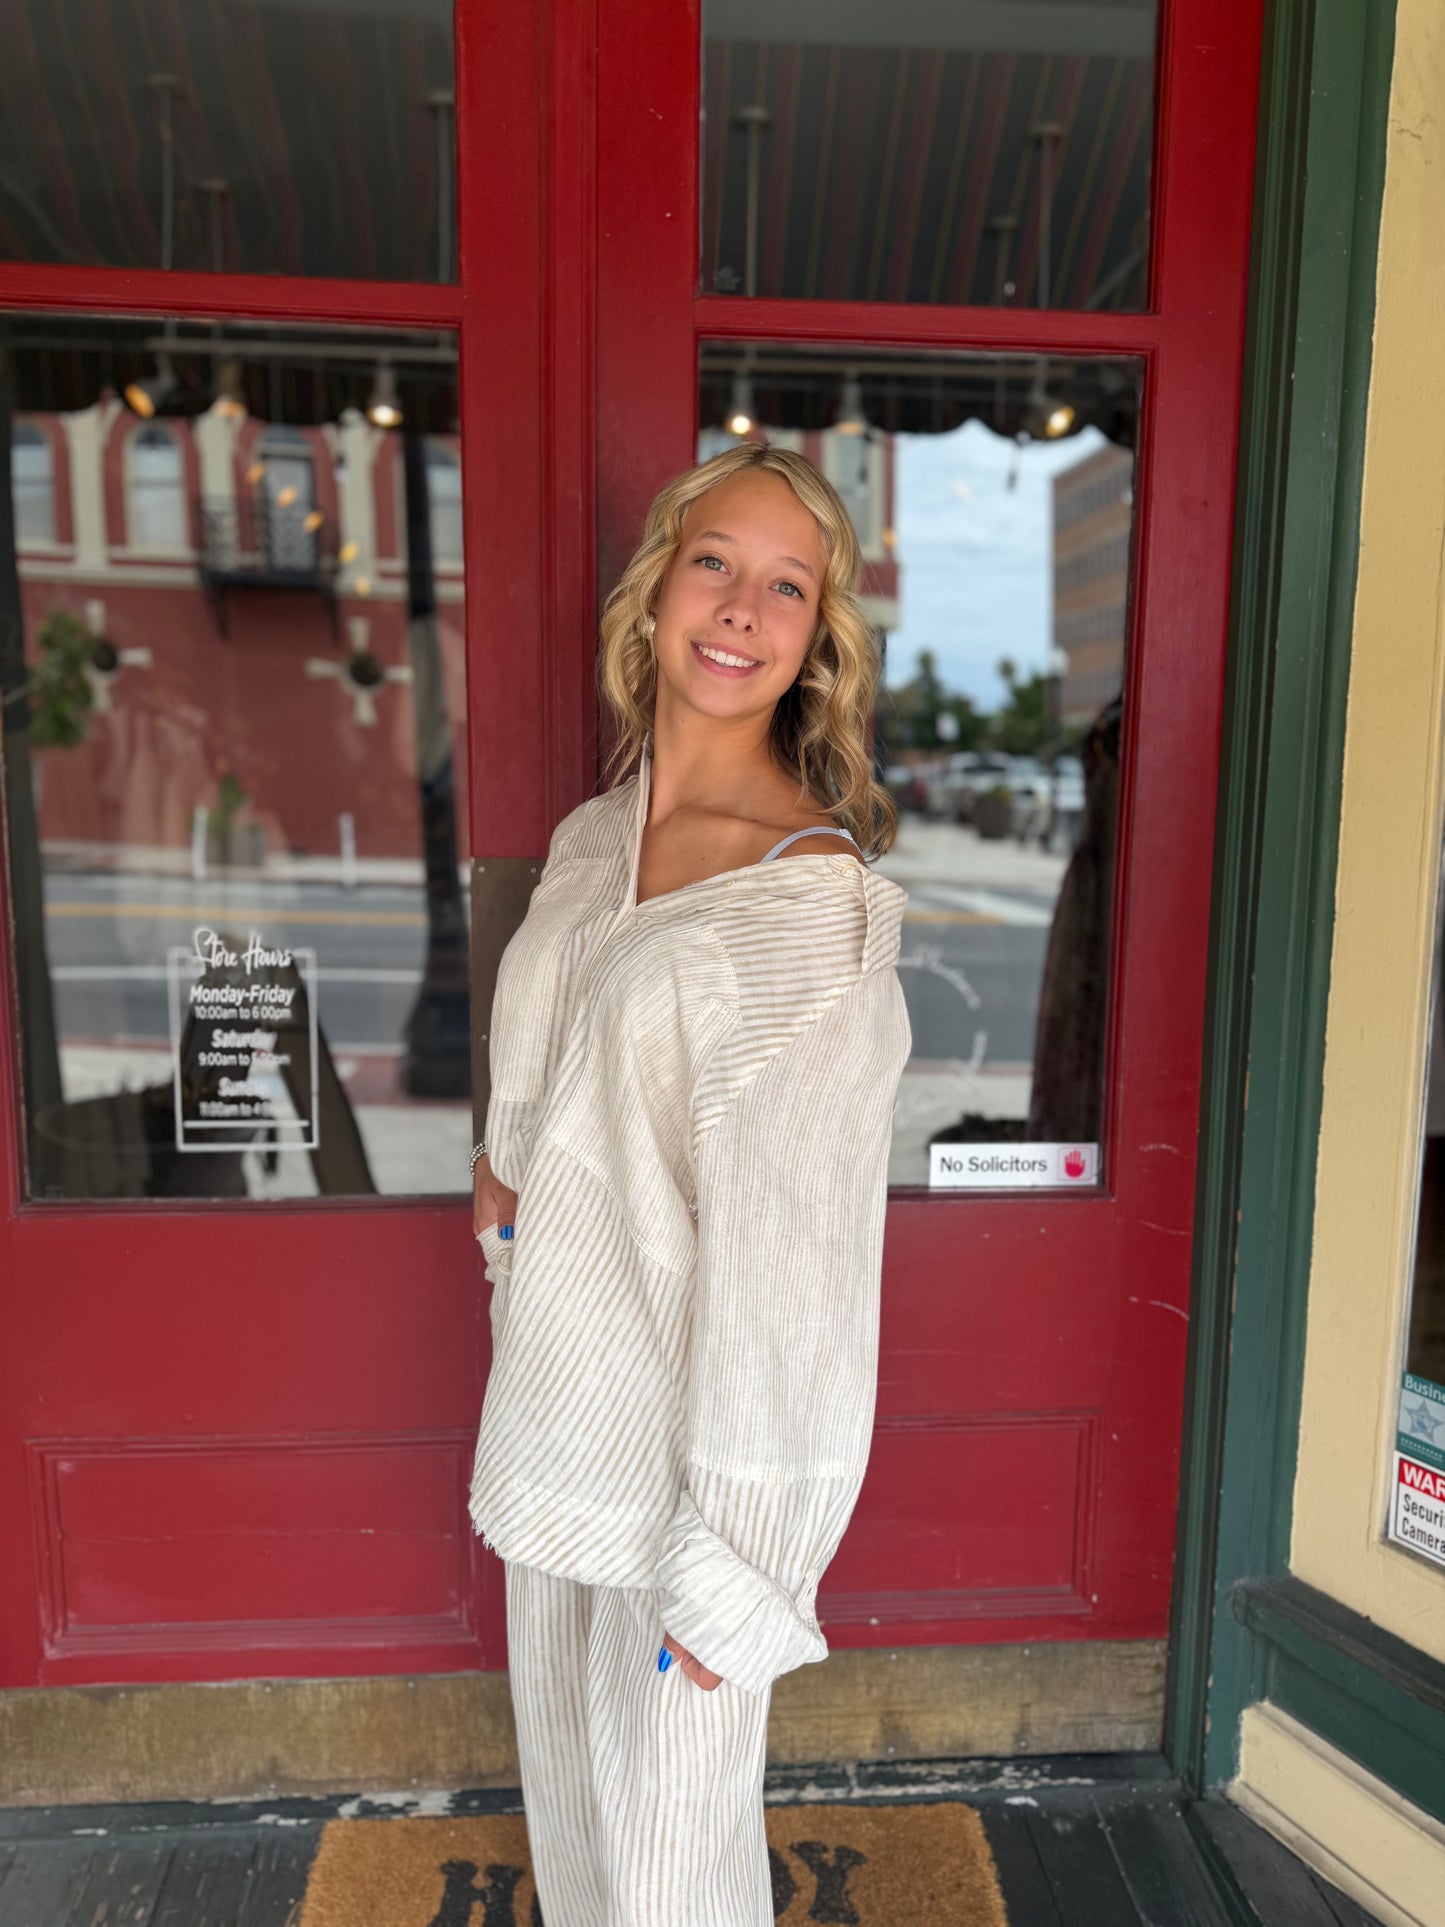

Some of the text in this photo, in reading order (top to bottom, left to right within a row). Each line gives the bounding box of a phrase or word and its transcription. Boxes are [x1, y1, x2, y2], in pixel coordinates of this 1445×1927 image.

[194, 928, 292, 976] Store Hours
[189, 984, 295, 1006] Monday-Friday
[239, 1006, 251, 1019] to
[238, 1052, 250, 1066] to
[940, 1156, 1048, 1172] No Solicitors
